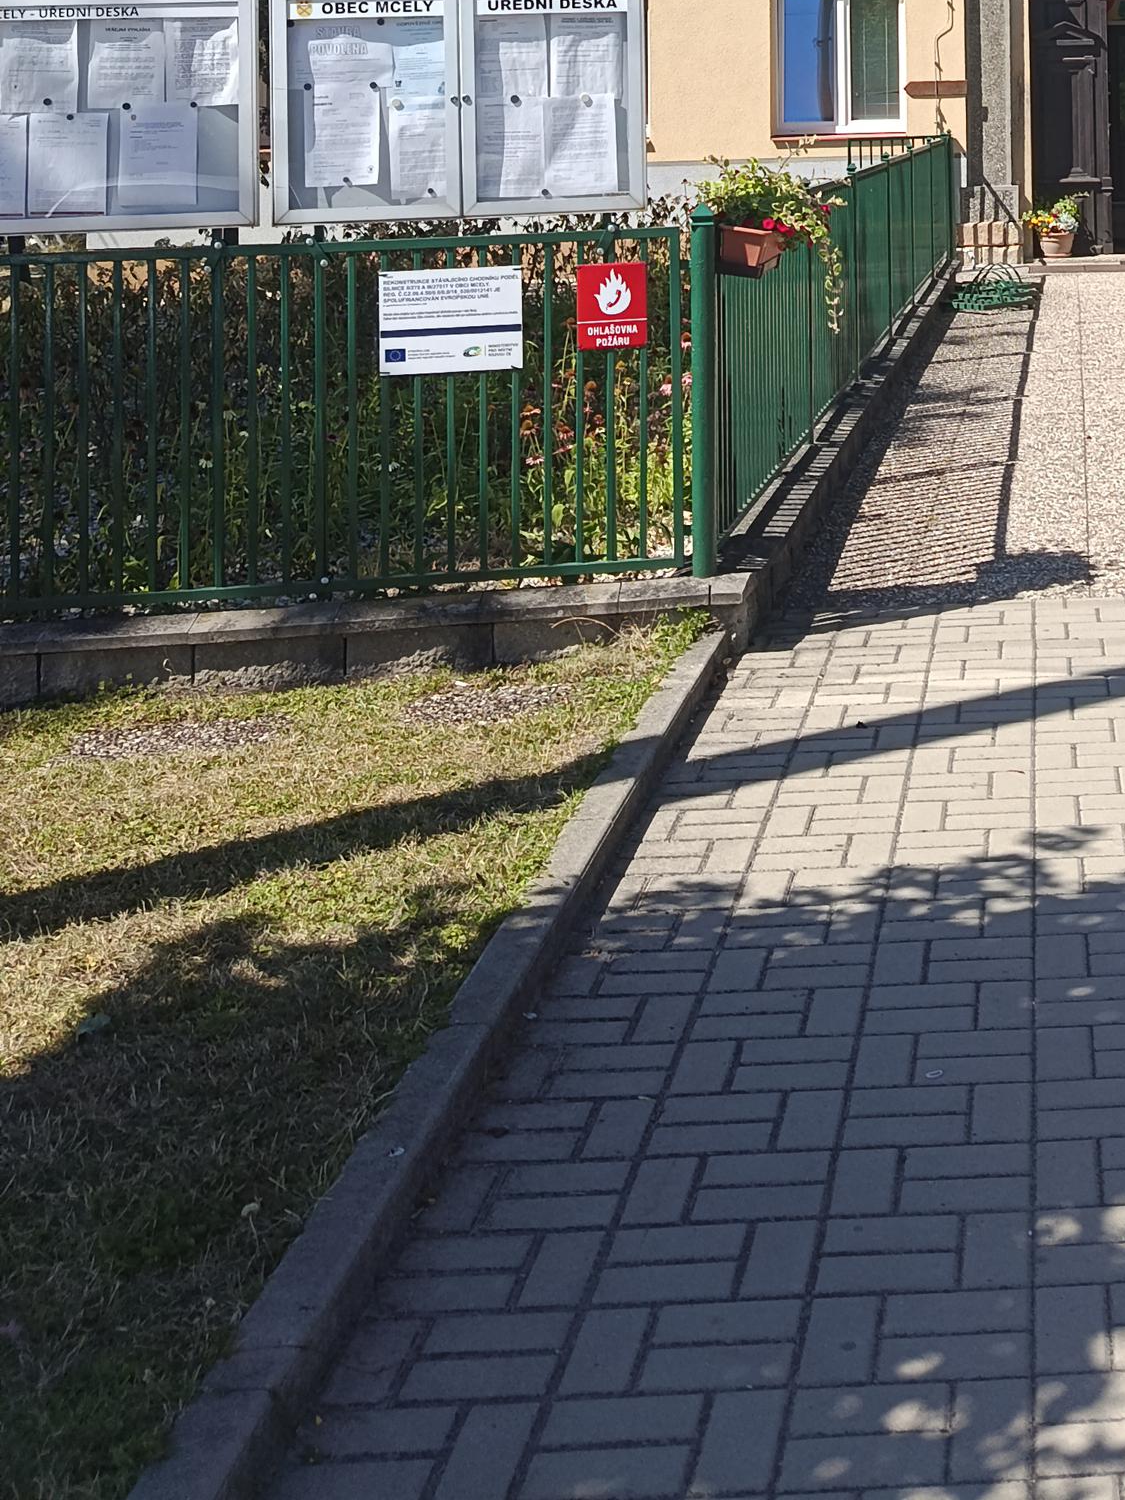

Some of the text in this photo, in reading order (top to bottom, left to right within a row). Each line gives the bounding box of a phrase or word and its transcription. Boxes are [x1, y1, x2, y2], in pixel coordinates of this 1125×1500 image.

[95, 6, 139, 18] DESKA
[321, 0, 434, 14] OBEC MCELY
[587, 324, 638, 336] OHLAŠOVNA
[596, 335, 630, 347] POŽÁRU
